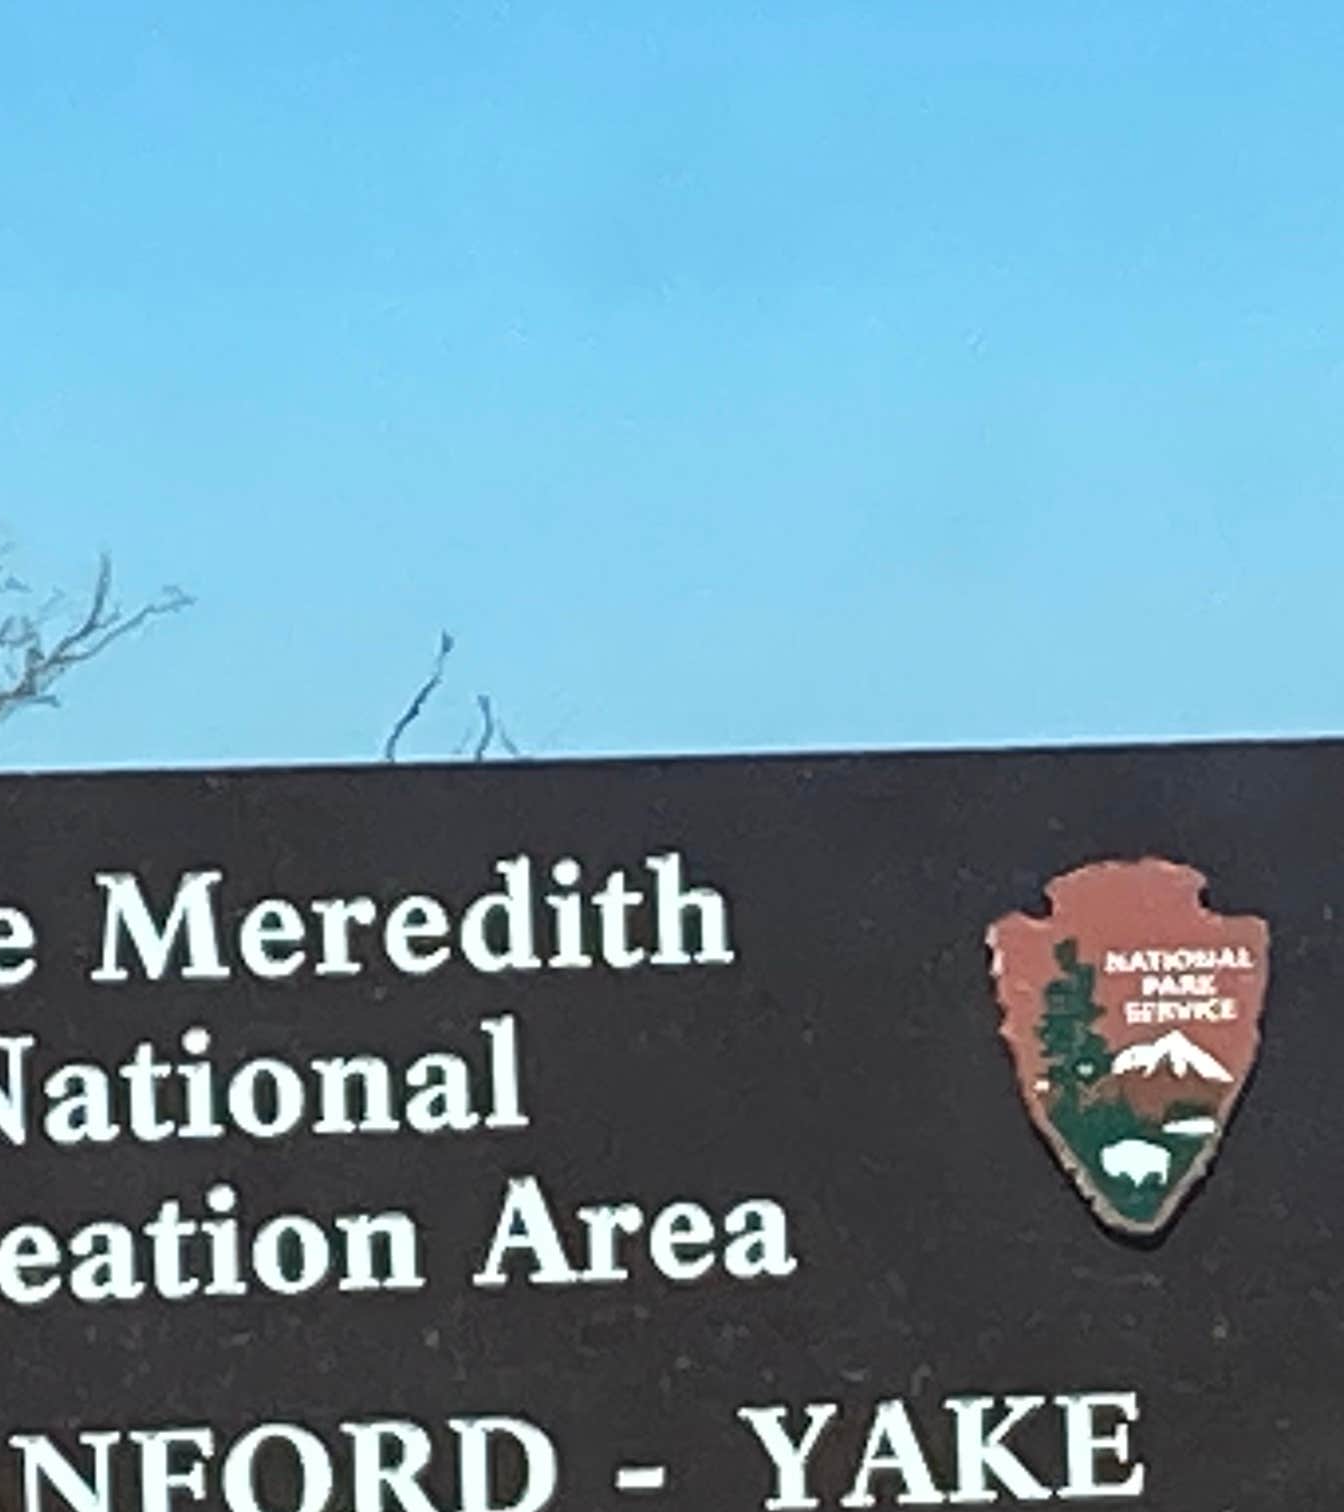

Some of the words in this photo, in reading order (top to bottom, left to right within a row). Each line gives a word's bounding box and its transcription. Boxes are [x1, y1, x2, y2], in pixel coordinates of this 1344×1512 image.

[90, 852, 735, 981] Meredith
[1104, 947, 1254, 974] NATIONAL
[1141, 974, 1218, 996] PARK
[1124, 998, 1238, 1025] SERVICE
[472, 1176, 798, 1286] Area
[616, 1466, 665, 1489] -
[737, 1391, 1145, 1511] YAKE
